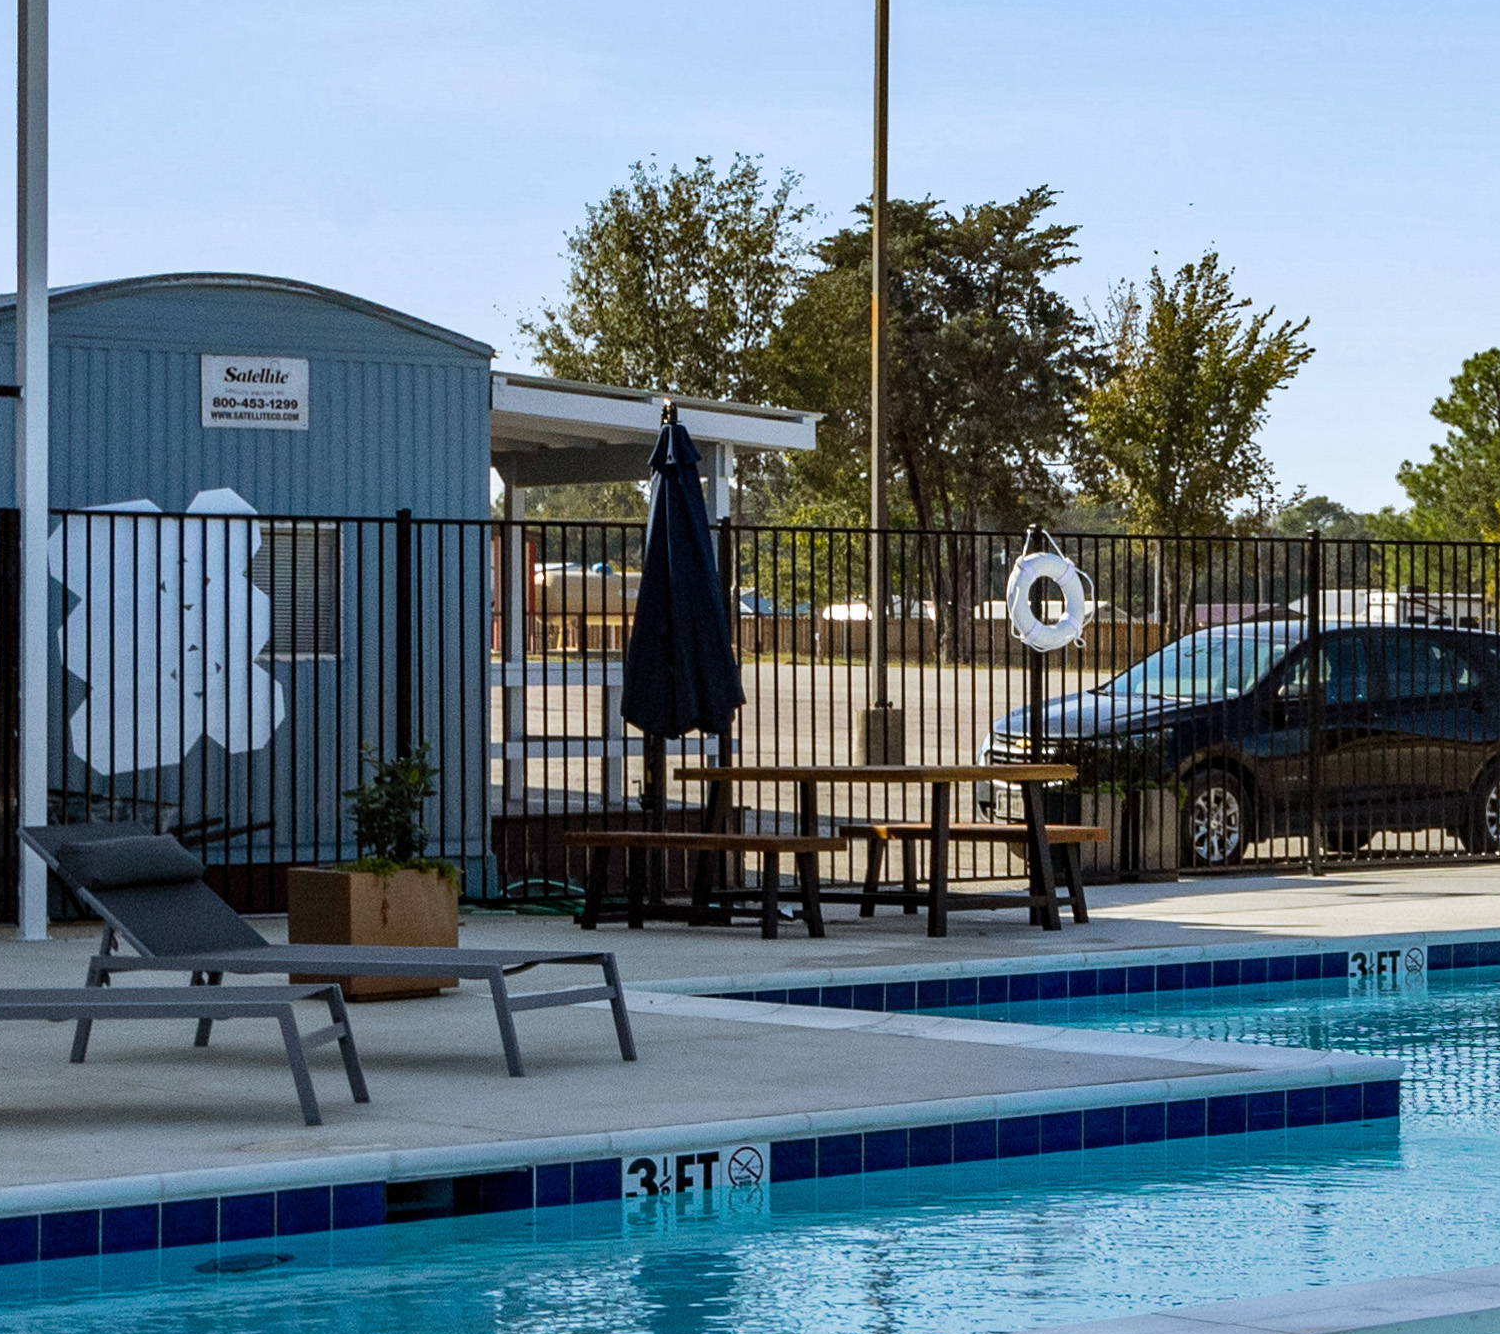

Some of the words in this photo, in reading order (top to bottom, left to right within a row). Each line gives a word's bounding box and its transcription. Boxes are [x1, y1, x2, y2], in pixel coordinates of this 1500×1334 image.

[224, 366, 289, 384] Satellite
[213, 397, 298, 409] 800-453-1299
[211, 411, 300, 421] WWW.SATELLITECO.COM
[1377, 950, 1401, 974] FT
[675, 1151, 719, 1193] FT
